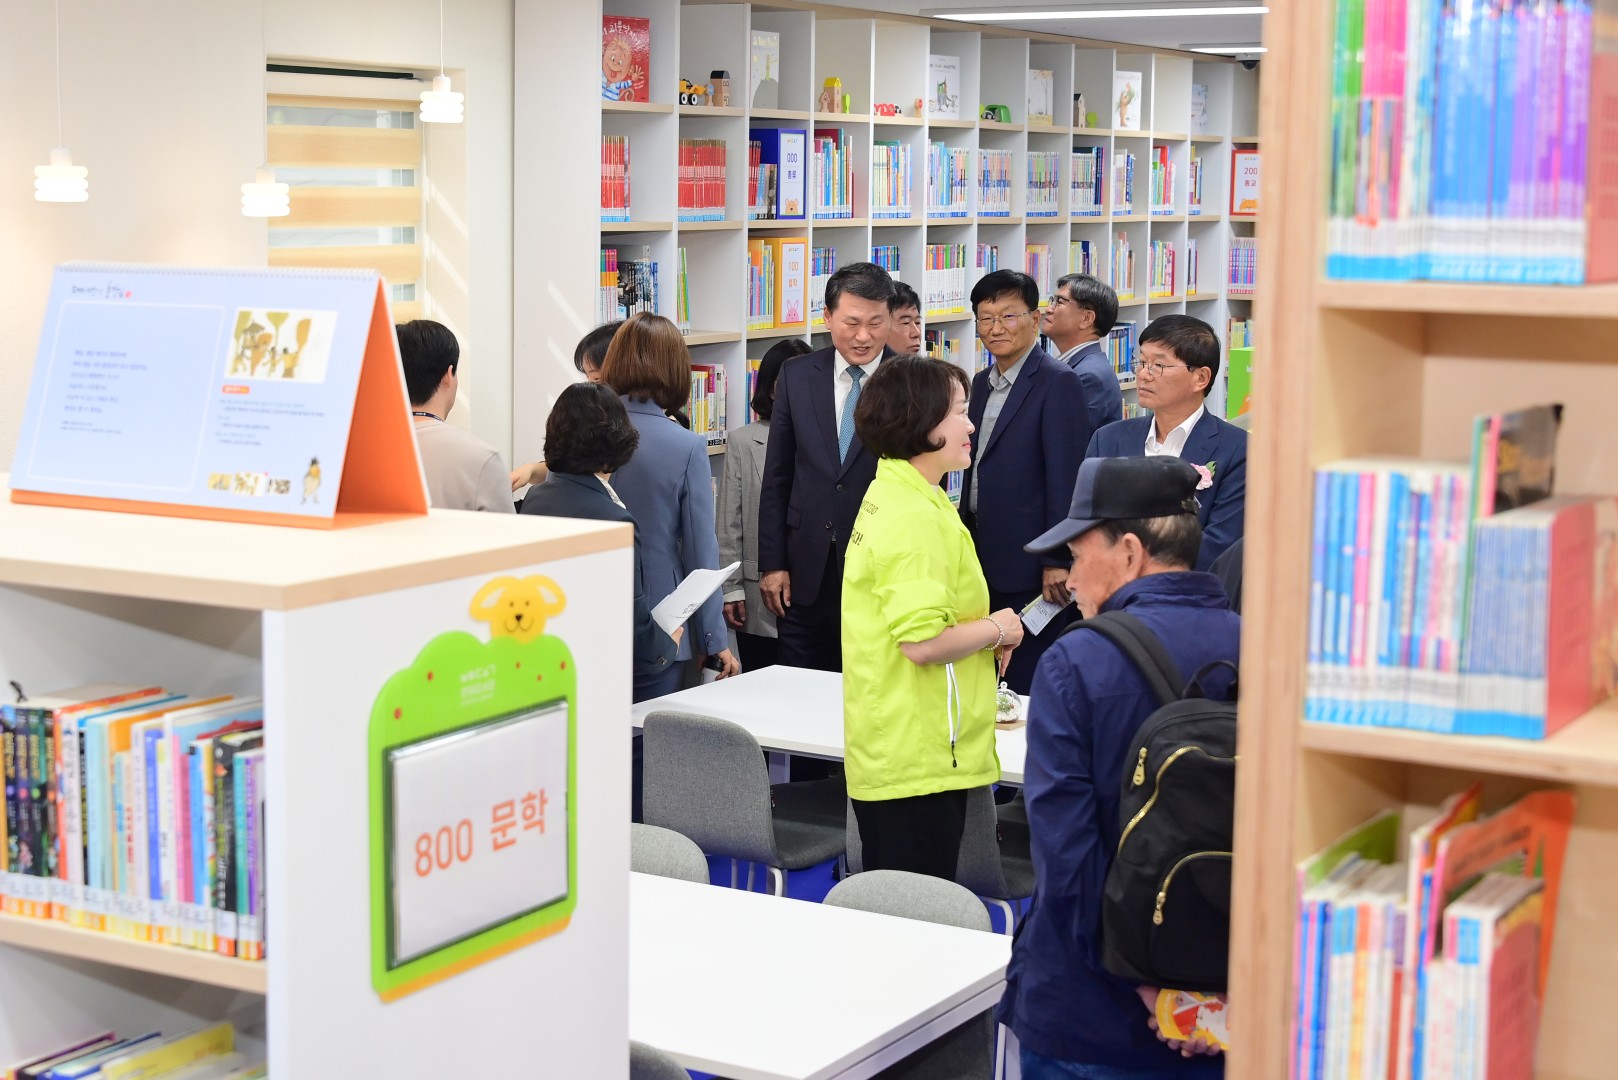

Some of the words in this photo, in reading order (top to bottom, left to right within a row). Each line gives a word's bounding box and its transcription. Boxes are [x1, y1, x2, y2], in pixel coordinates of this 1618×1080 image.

[787, 153, 798, 163] 000
[1244, 167, 1258, 175] 200
[788, 261, 799, 271] 100
[415, 817, 473, 878] 800
[490, 787, 548, 852] 문학
